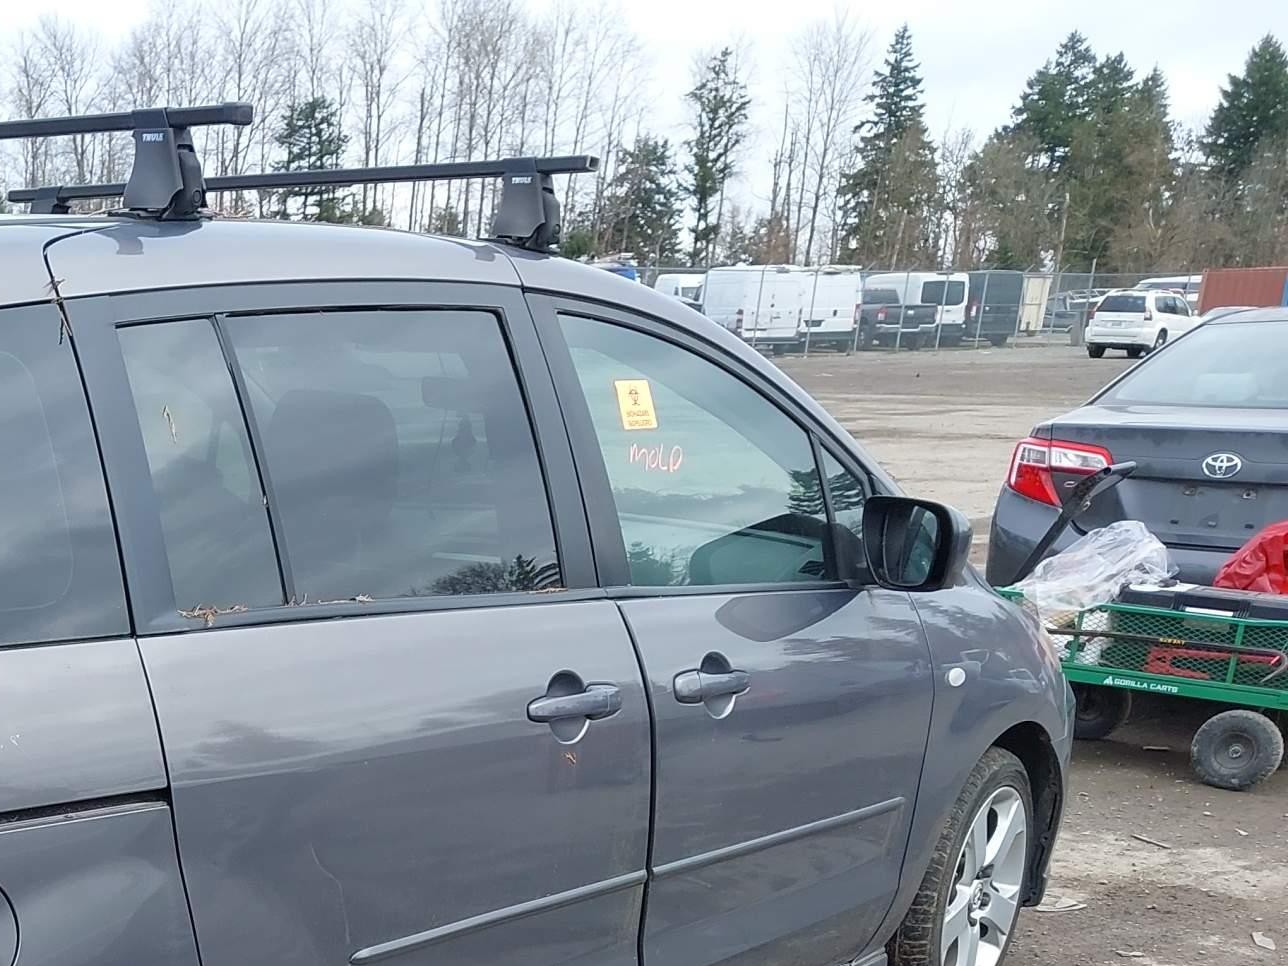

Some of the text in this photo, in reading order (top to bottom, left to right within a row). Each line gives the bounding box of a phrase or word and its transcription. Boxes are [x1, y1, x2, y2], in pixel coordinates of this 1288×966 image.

[142, 133, 164, 142] THULE
[629, 443, 683, 472] MOLD
[1114, 678, 1179, 693] GORILLA CARTS
